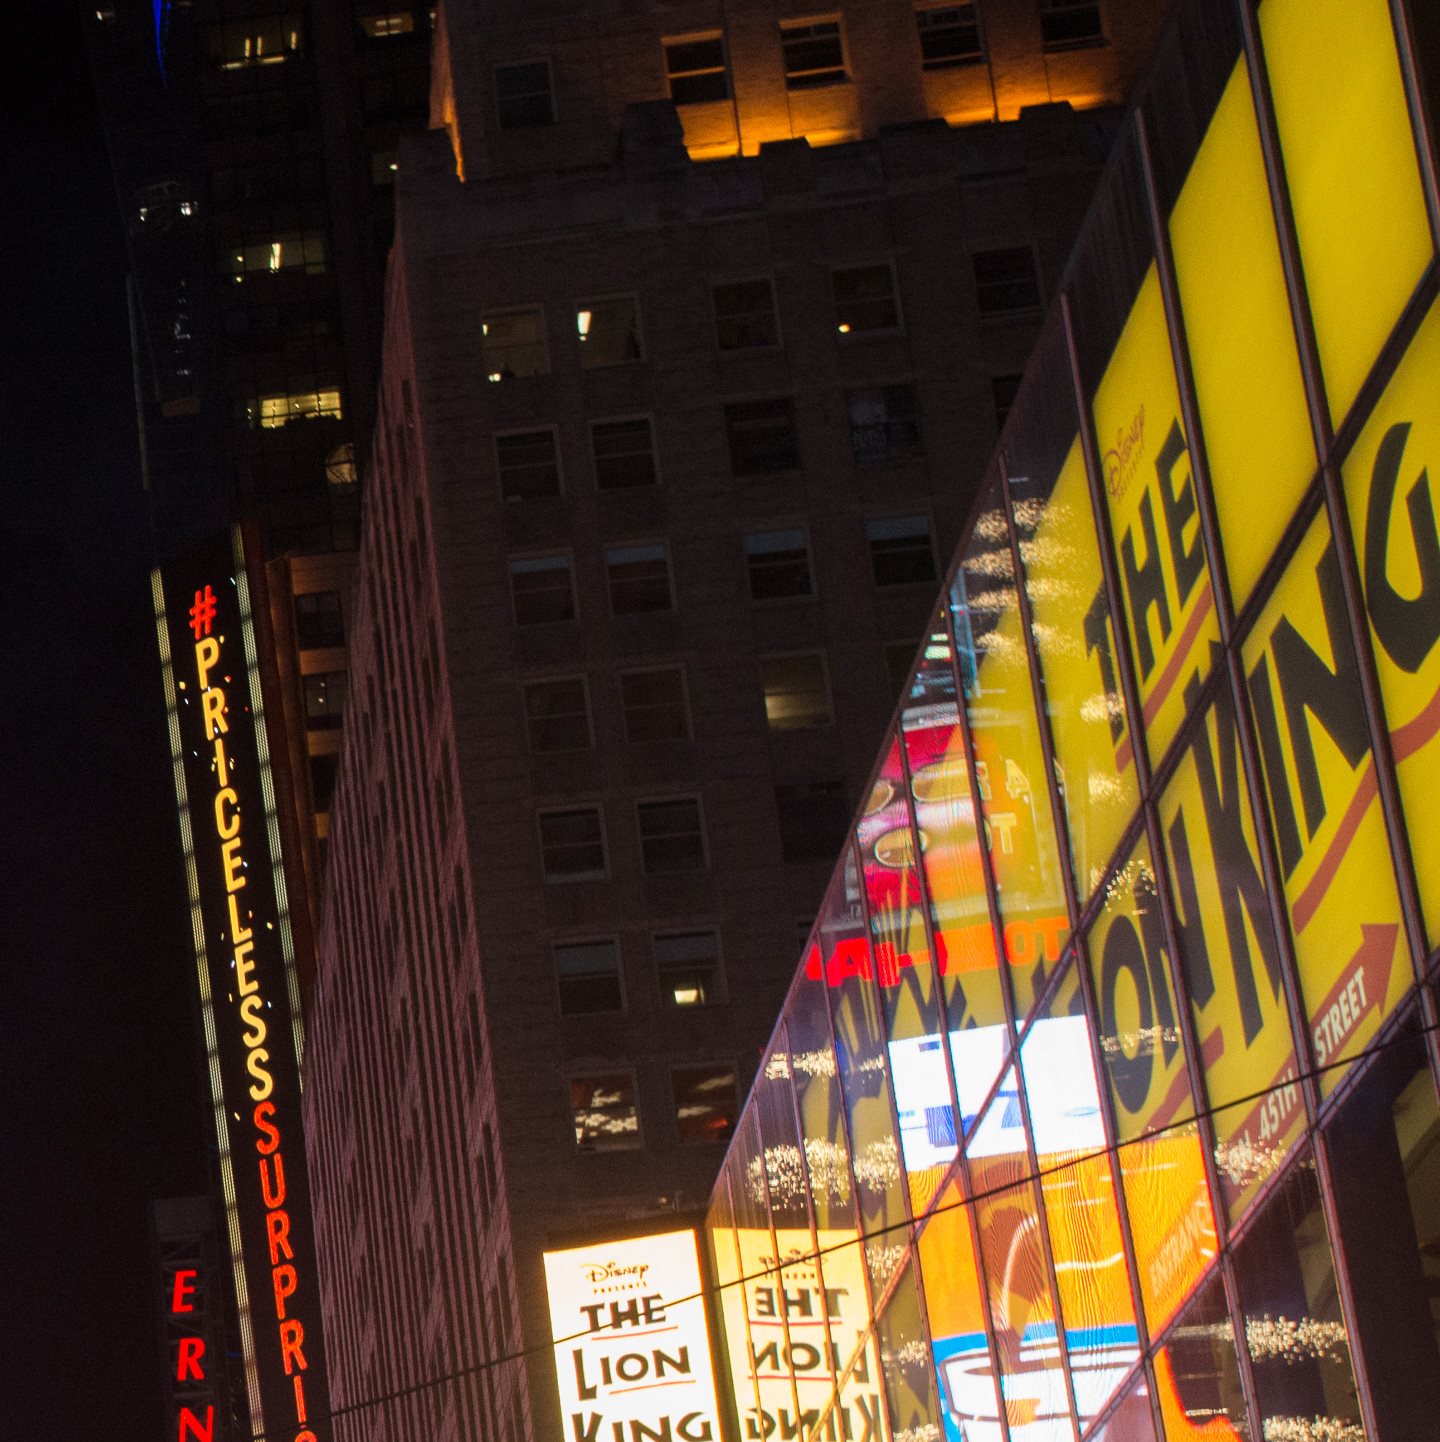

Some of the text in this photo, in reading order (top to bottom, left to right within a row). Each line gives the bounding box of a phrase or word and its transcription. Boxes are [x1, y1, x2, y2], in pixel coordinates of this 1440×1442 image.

[1257, 970, 1367, 1144] 45TH STREET
[580, 1293, 667, 1334] THE
[571, 1345, 693, 1402] LION
